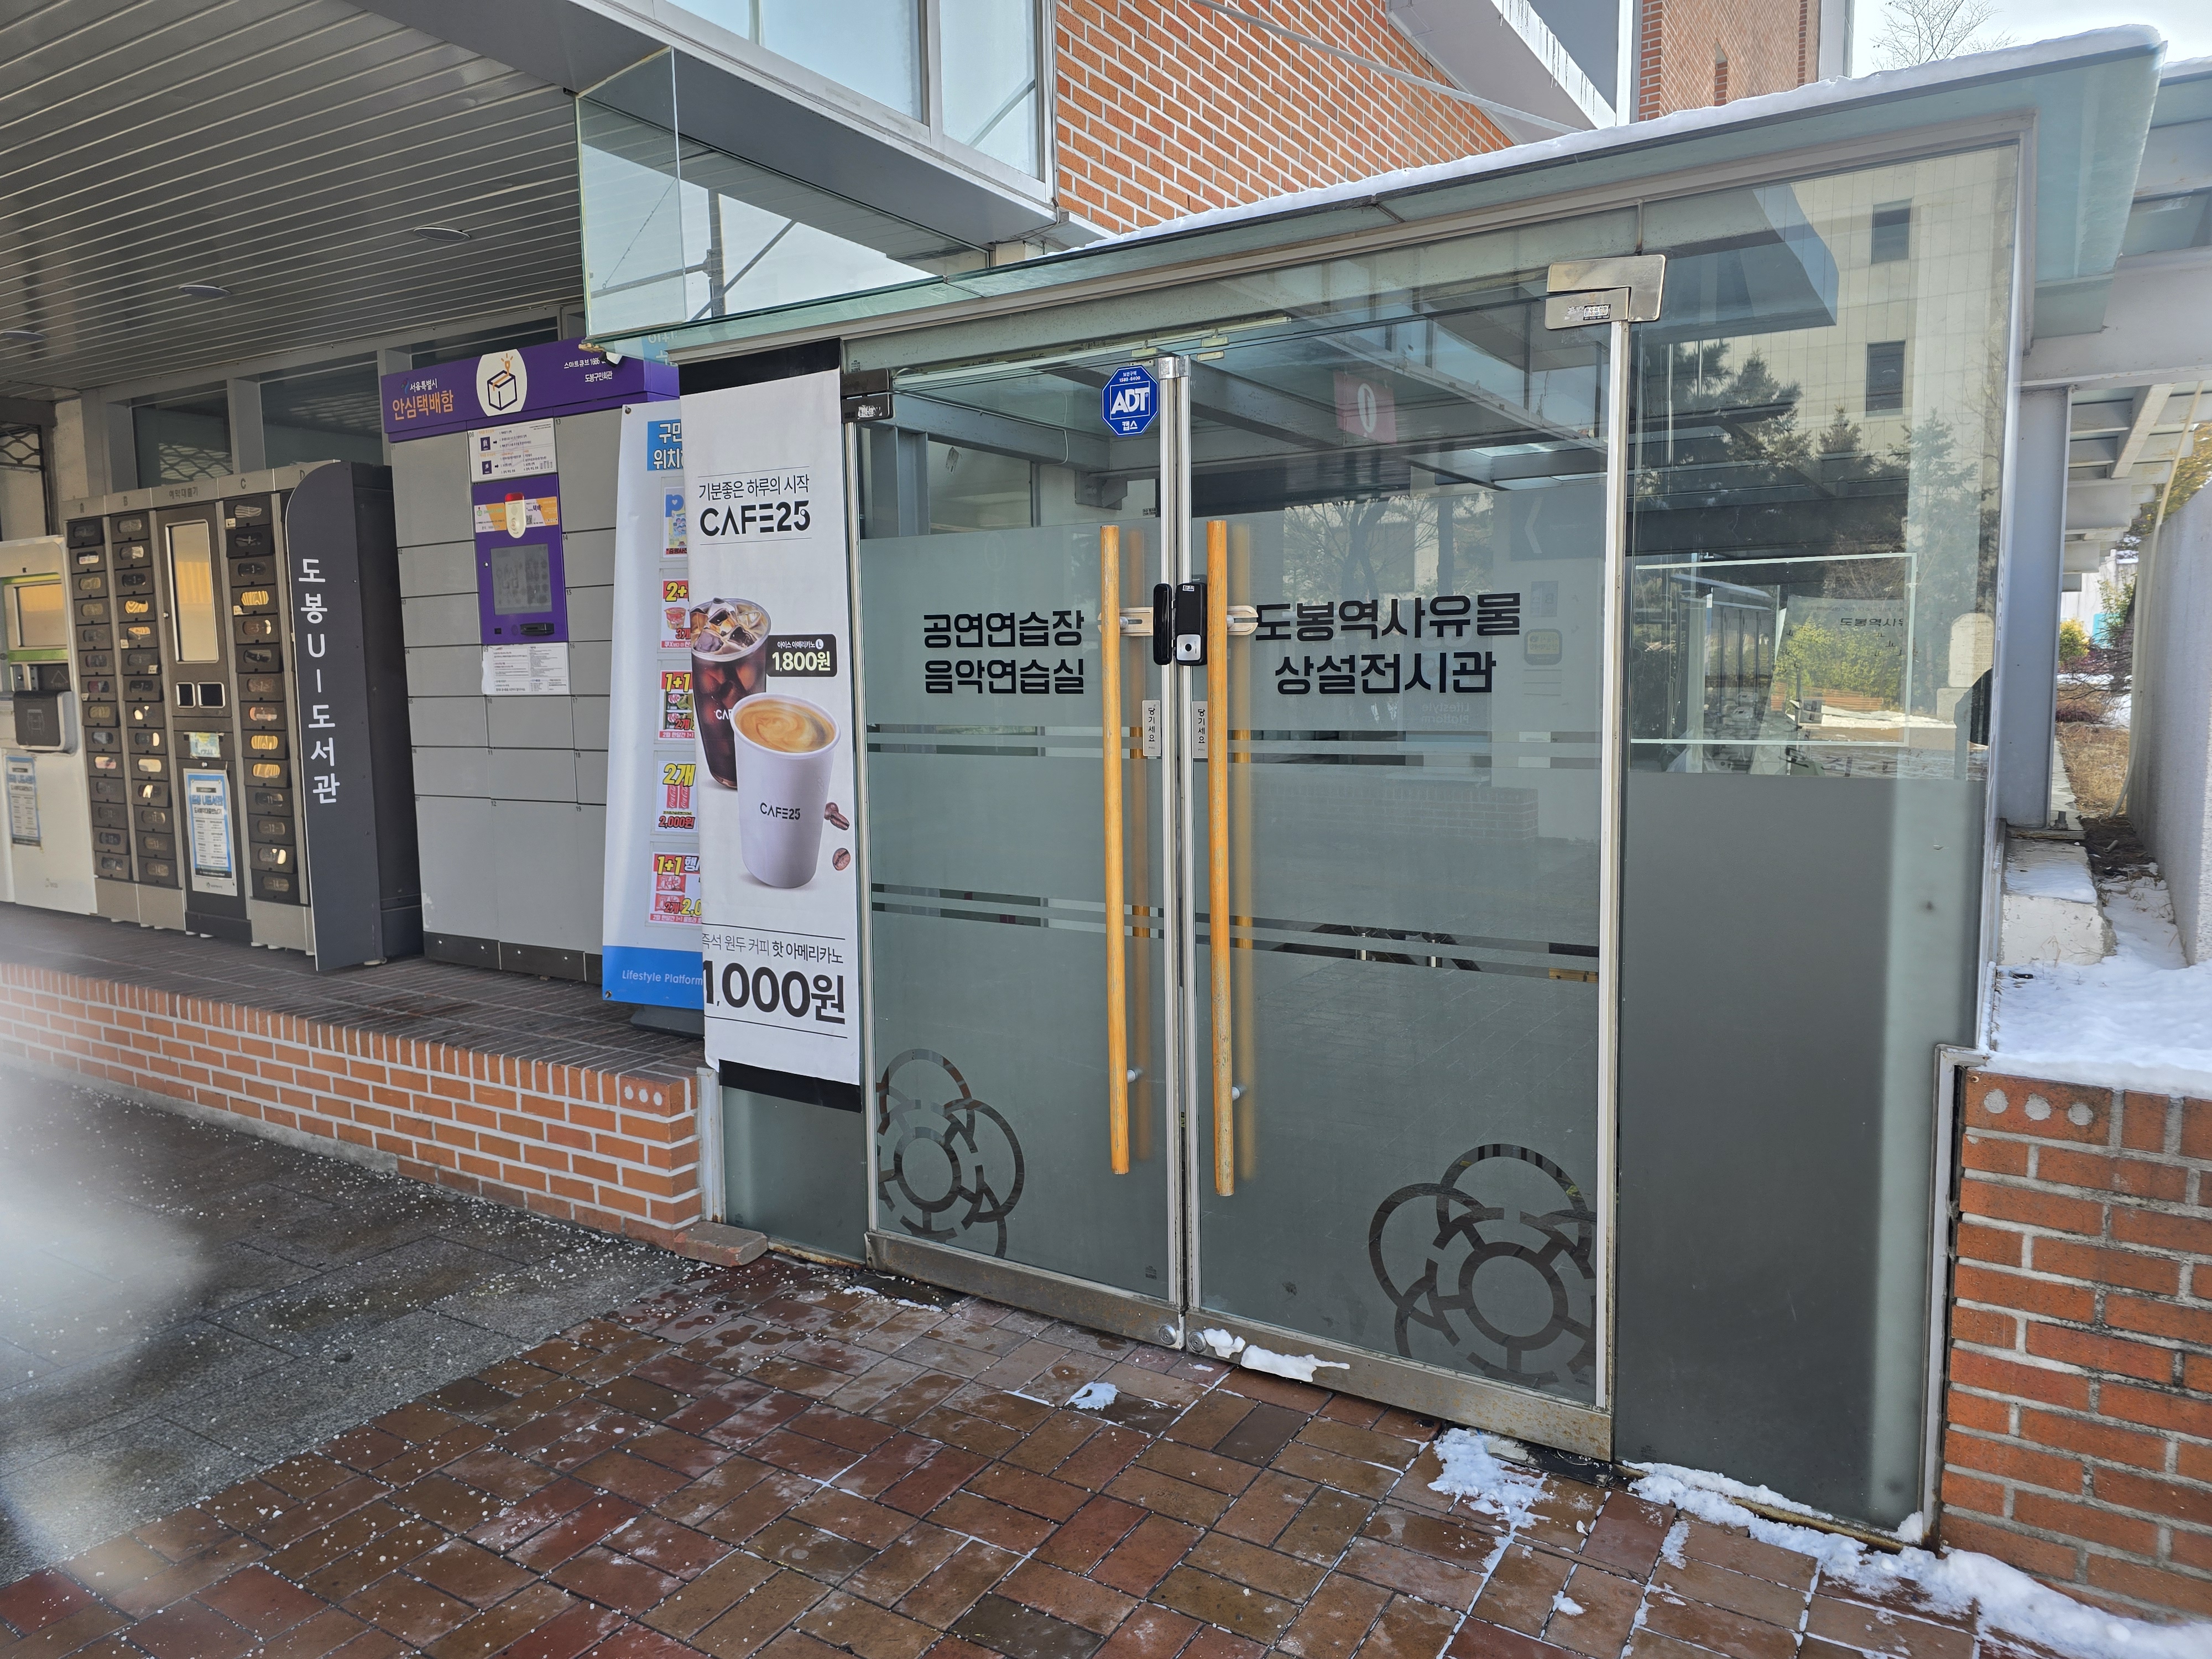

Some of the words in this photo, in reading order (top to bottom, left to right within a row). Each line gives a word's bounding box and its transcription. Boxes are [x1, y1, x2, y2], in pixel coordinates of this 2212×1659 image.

[564, 359, 589, 369] 스마트큐브
[410, 378, 438, 393] 서울특별시
[585, 371, 613, 382] 도봉구민회관
[392, 389, 454, 421] 안심택배함
[1110, 387, 1149, 414] ADT
[1122, 420, 1138, 431] 캡스
[653, 448, 684, 470] 위치
[241, 478, 246, 489] C
[699, 480, 744, 501] 기분좋은
[747, 476, 781, 497] 하루의
[784, 474, 810, 494] 시작
[700, 500, 811, 536] CAFE25
[1255, 593, 1521, 641] 도봉역사유물
[924, 610, 1084, 648] 공연연습장
[777, 640, 792, 649] 아이스
[792, 640, 816, 649] 아메리카노
[772, 651, 831, 672] 1,800원
[665, 672, 691, 692] 1+1
[925, 659, 1084, 695] 음악연습실
[1275, 651, 1497, 695] 상설전시관
[675, 719, 691, 731] 2개
[662, 763, 696, 787] 2개
[760, 802, 801, 821] CAFE25
[658, 816, 696, 829] 2,000원
[657, 855, 683, 876] 1+1
[702, 933, 722, 950] 즉석
[724, 935, 747, 953] 원두
[749, 938, 770, 956] 커피
[772, 941, 784, 958] 핫
[786, 942, 844, 964] 아메리카노
[622, 970, 662, 983] Lifestyle
[665, 973, 703, 985] Platform
[703, 960, 846, 1025] 1,000원
